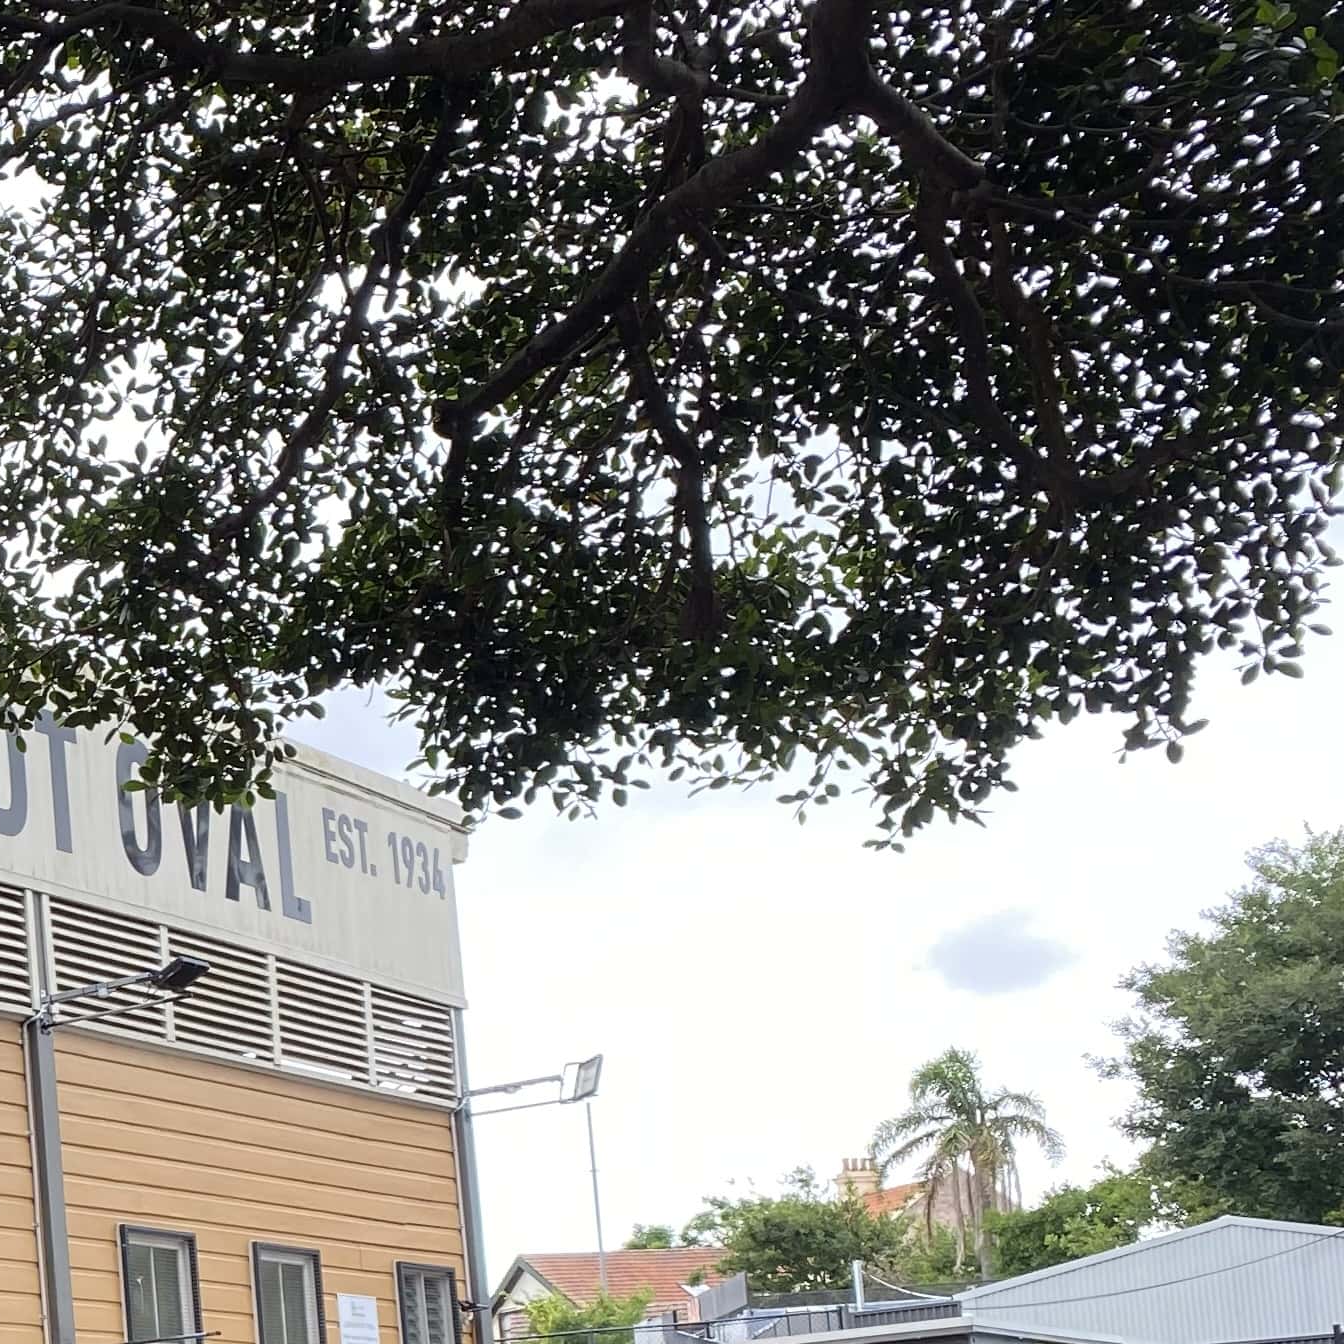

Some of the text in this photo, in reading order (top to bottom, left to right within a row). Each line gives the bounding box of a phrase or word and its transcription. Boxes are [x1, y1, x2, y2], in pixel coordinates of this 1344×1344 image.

[115, 738, 313, 925] OVAL
[321, 806, 446, 900] EST. 1934
